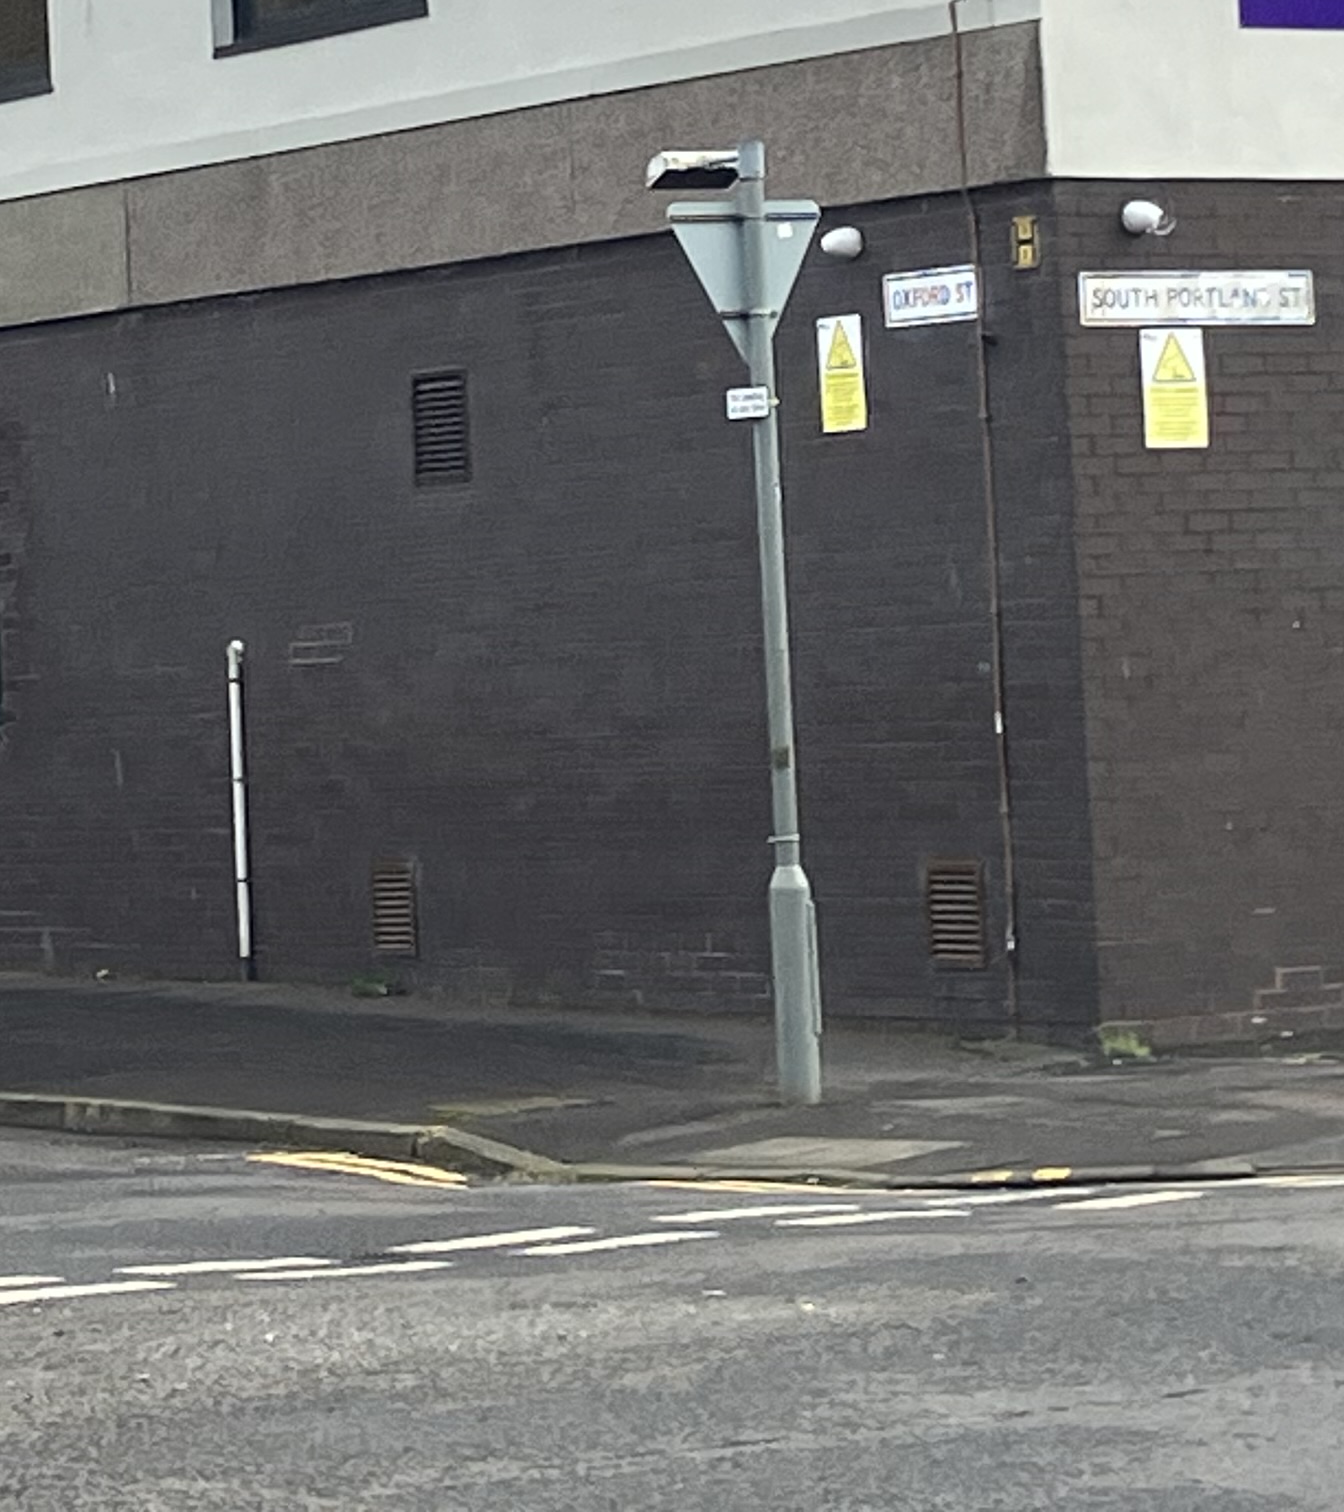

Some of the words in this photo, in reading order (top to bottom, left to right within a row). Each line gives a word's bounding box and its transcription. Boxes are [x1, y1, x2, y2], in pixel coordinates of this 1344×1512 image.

[892, 284, 951, 311] OXFORD
[955, 279, 974, 304] ST
[1091, 287, 1158, 309] SOUTH
[1278, 287, 1301, 308] ST
